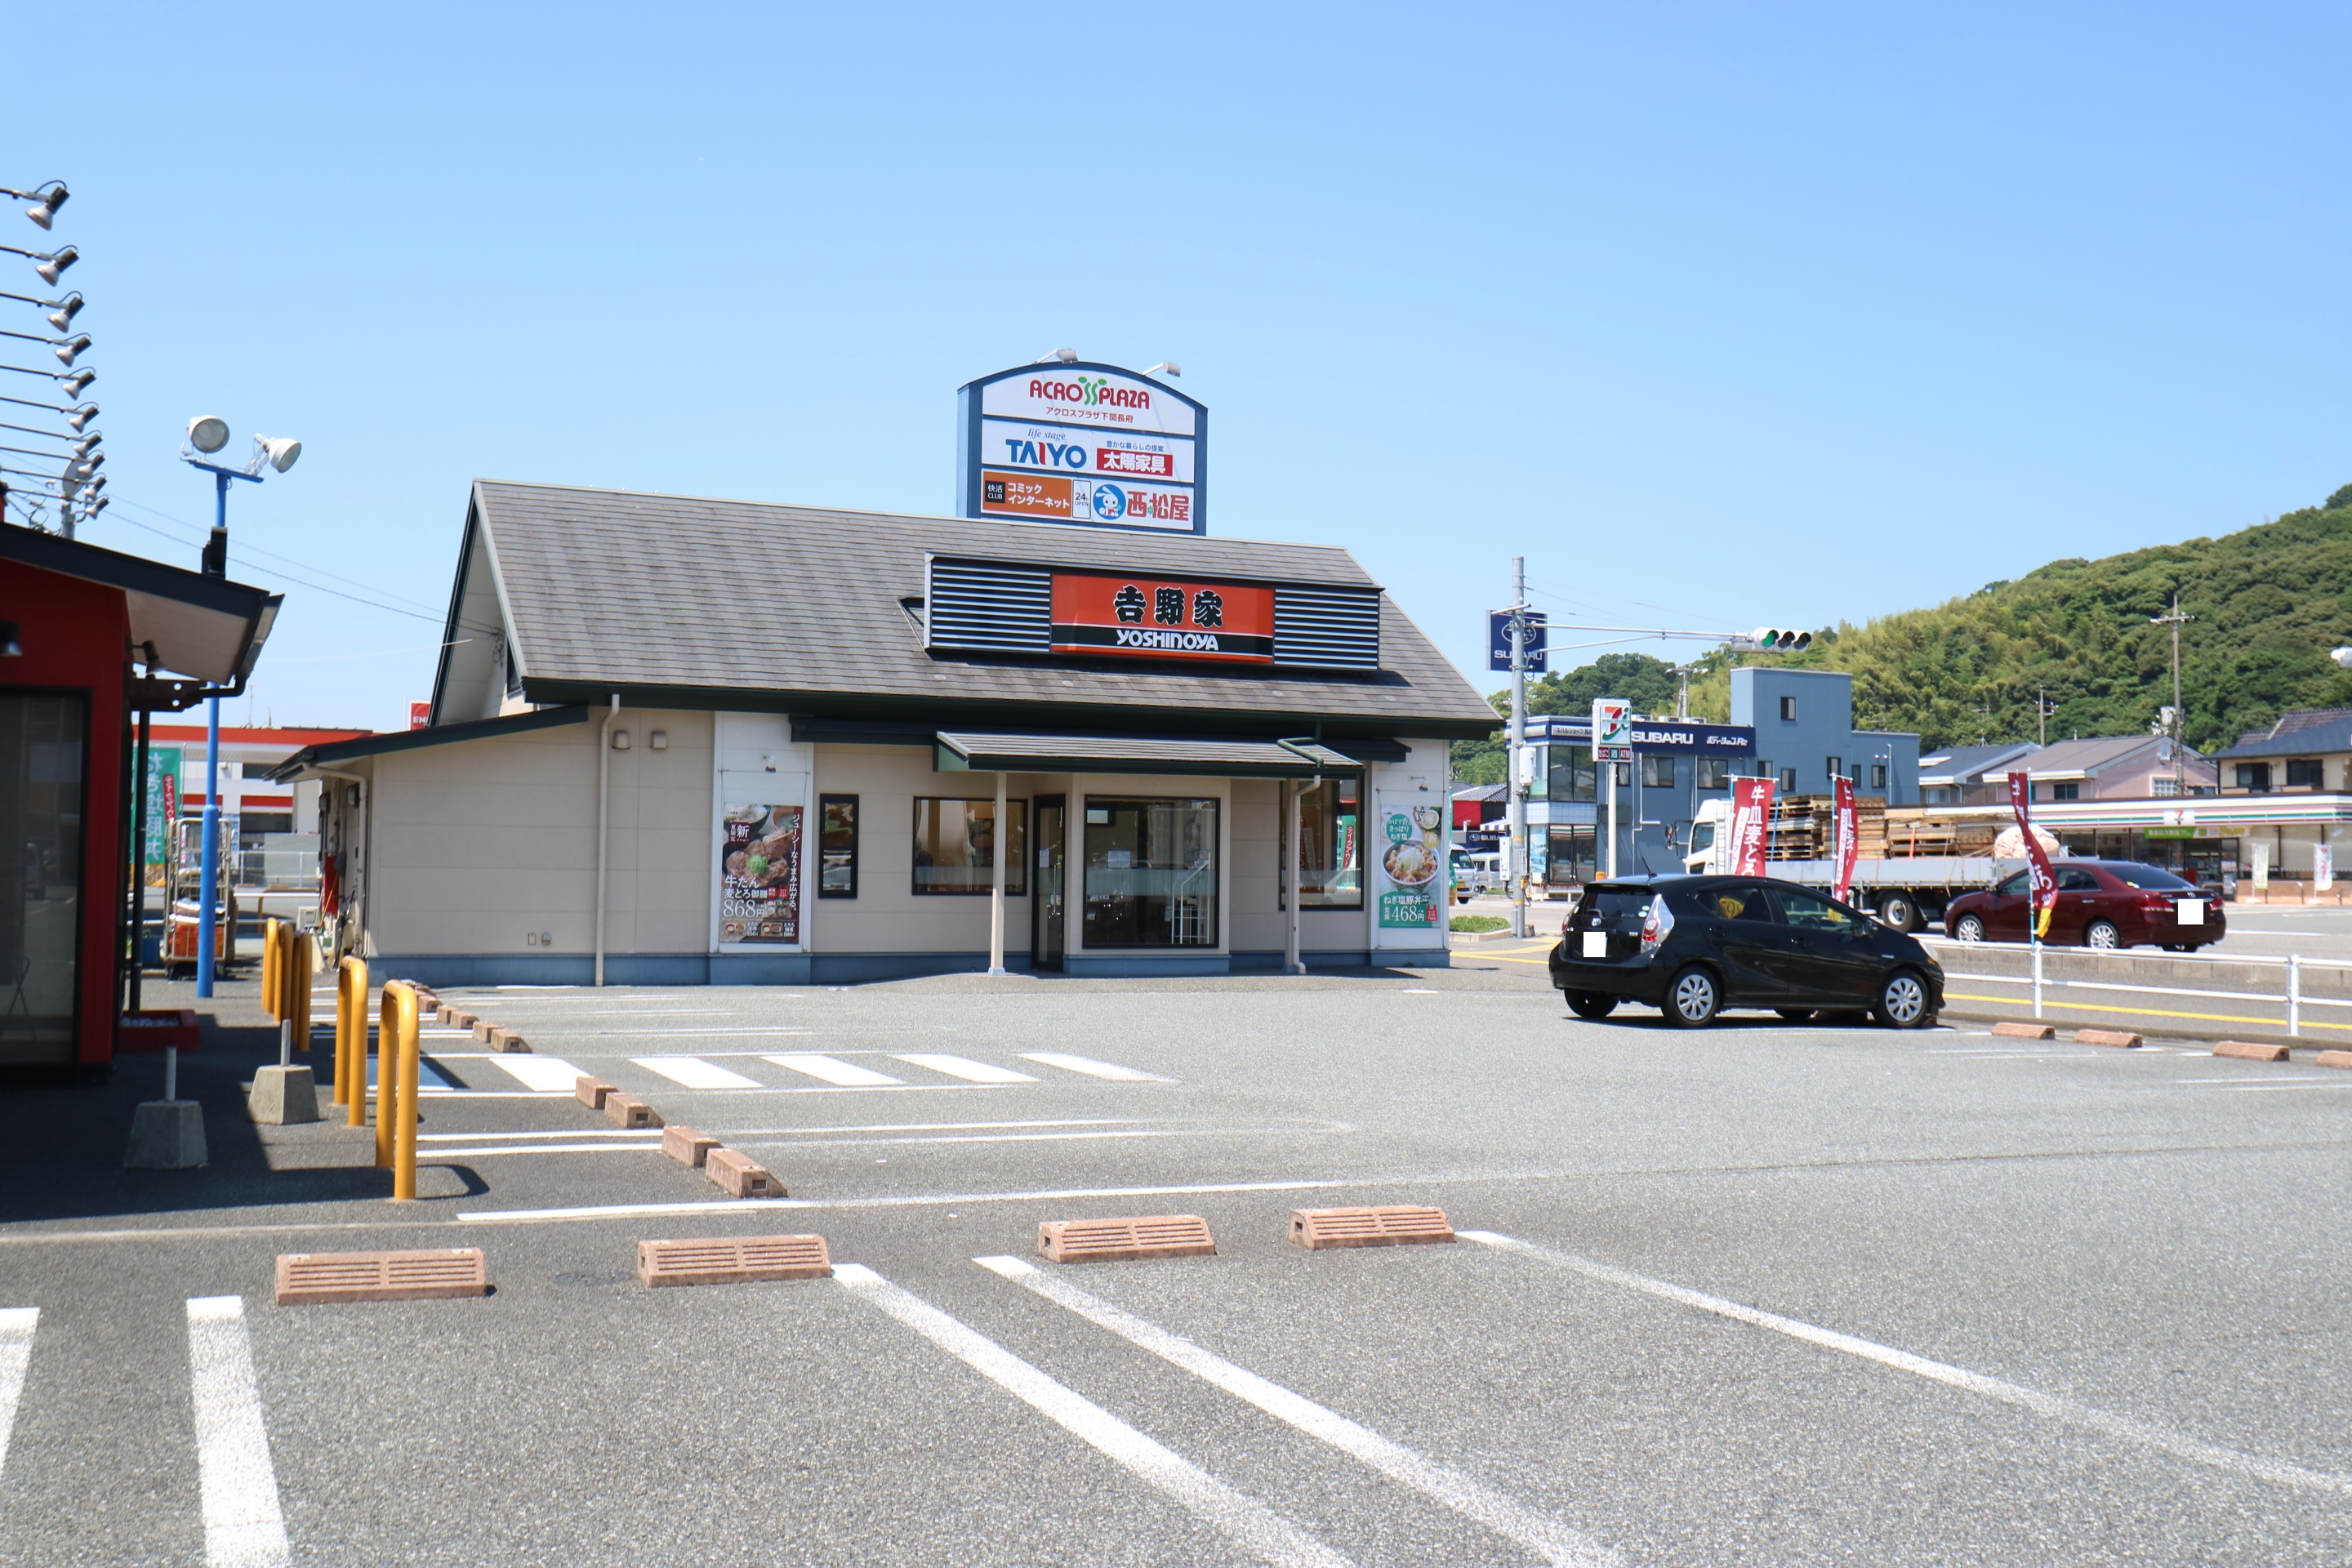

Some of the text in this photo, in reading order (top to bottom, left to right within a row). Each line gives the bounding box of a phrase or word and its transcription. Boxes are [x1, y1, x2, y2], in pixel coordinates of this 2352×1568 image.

[1098, 387, 1150, 409] PLAZA
[1046, 407, 1134, 423] アクロスプラザ下関長府
[1028, 429, 1066, 440] life stage
[1106, 441, 1165, 452] 豊かな暮らしの提案
[1005, 439, 1087, 469] TAIYO
[1103, 451, 1166, 474] 太陽家具
[987, 483, 1003, 492] 快活
[1007, 482, 1043, 494] コミック
[1008, 495, 1071, 510] インターネット
[1126, 490, 1190, 522] 西松屋
[1113, 584, 1223, 628] 吉野家
[1116, 630, 1219, 651] YOSHINOYA
[1631, 731, 1694, 745] SUBARU
[1620, 749, 1630, 758] ATM
[737, 824, 750, 838] 新
[1389, 825, 1410, 833] さっぱり
[1390, 833, 1408, 841] ねぎ塩
[789, 813, 800, 911] ジューシーなうまみ広がる。
[724, 874, 760, 889] 牛たん
[1383, 895, 1423, 905] ねぎ塩豚丼
